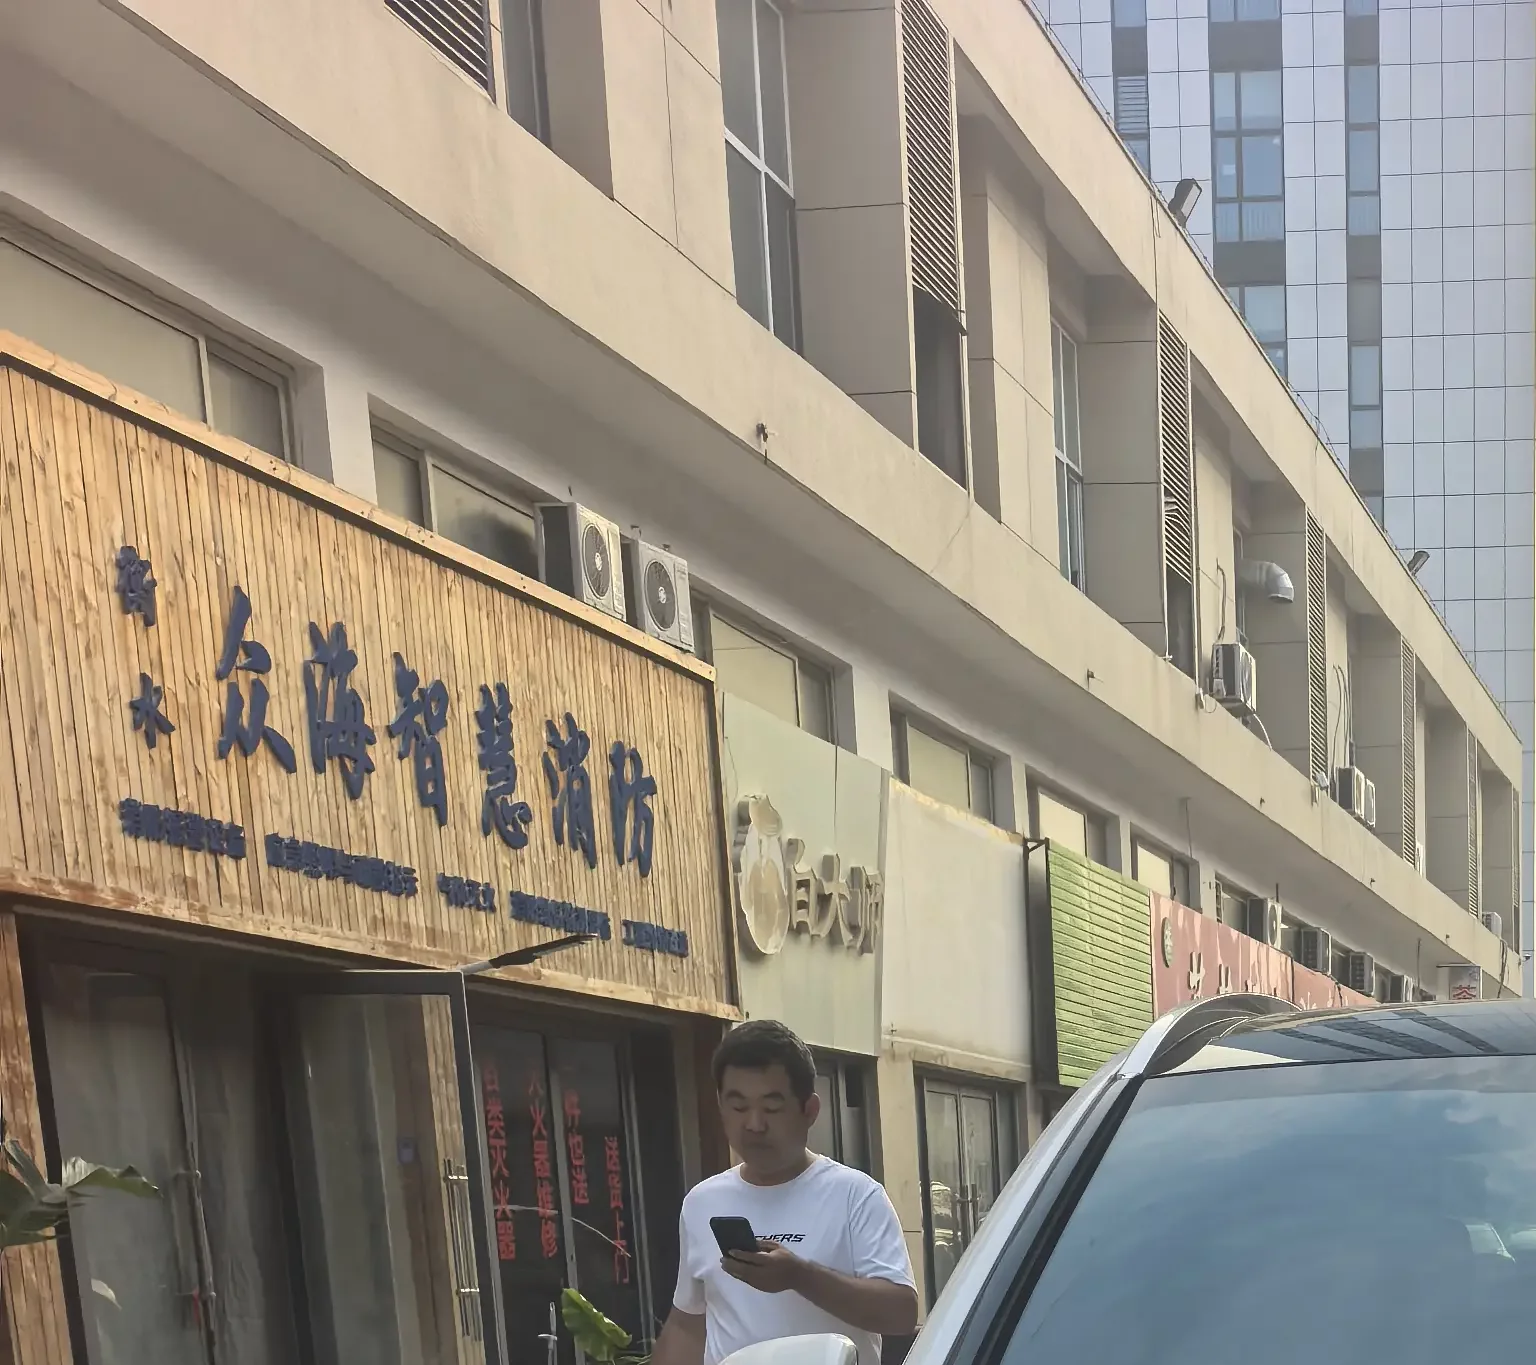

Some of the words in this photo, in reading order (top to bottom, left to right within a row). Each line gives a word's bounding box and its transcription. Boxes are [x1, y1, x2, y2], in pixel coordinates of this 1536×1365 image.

[215, 584, 656, 879] 众海智慧消防
